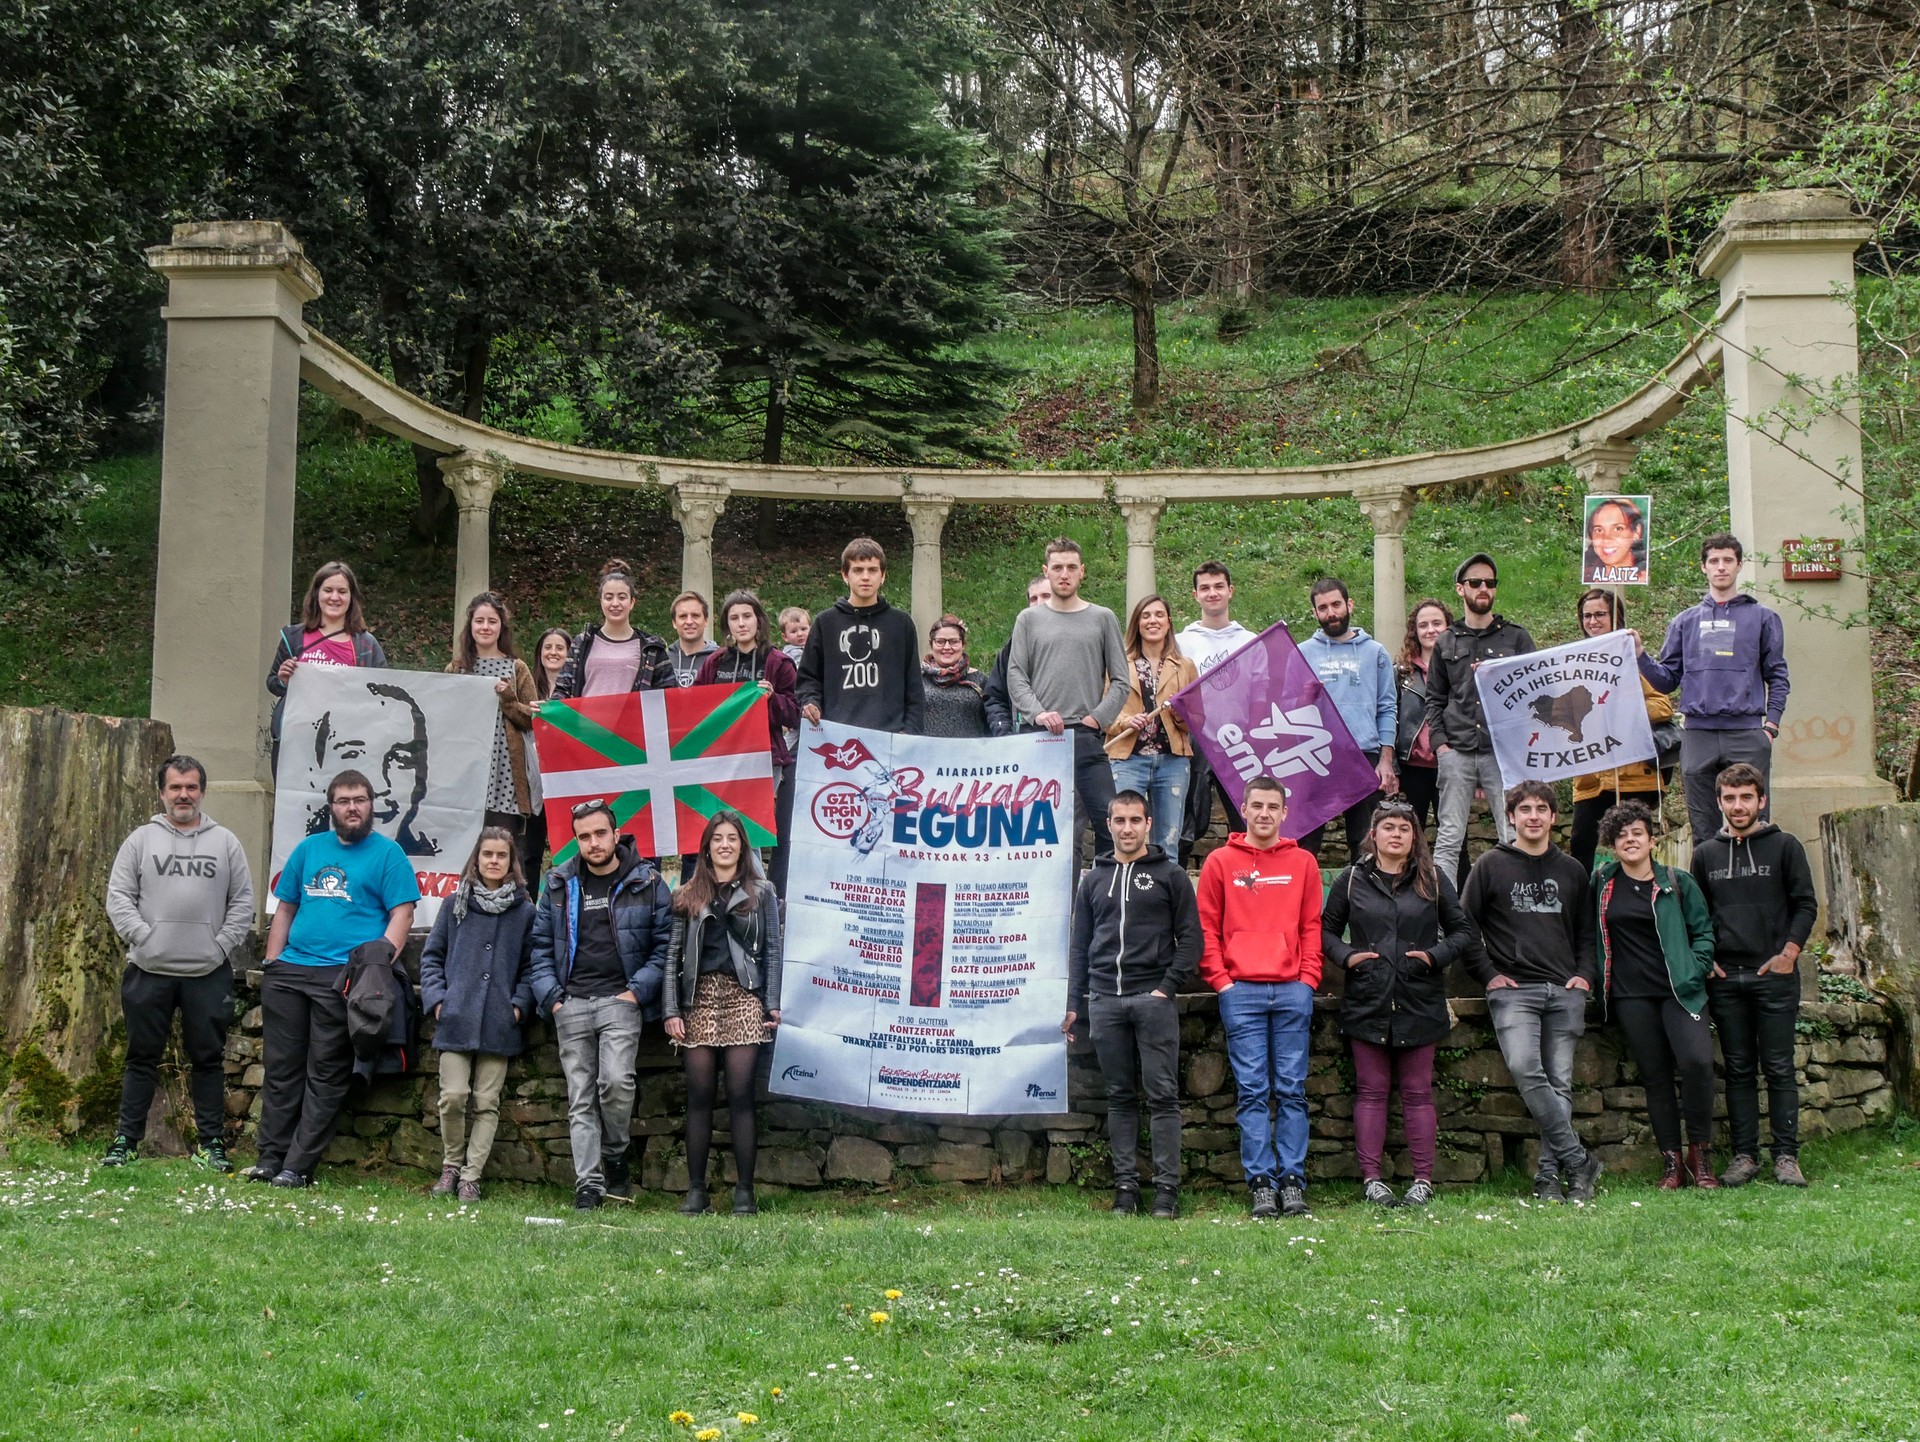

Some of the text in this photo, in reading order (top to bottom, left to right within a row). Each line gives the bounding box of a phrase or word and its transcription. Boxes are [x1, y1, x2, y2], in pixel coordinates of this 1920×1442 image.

[1592, 566, 1639, 582] ALAITZ
[302, 649, 327, 659] mihi
[842, 662, 879, 690] ZOO
[1493, 652, 1623, 696] EUSKAL PRESO
[1503, 669, 1621, 711] ETA IHESLARIAK
[1526, 735, 1623, 768] ETXERA
[937, 764, 1020, 777] AIARALDEKO
[826, 793, 856, 805] GZT
[821, 806, 862, 818] TPGN
[836, 818, 855, 831] 19
[892, 798, 1060, 849] EGUNA
[899, 849, 967, 862] MARTXOAK
[974, 853, 989, 862] 23
[1008, 850, 1053, 861] LAUDIO
[152, 854, 217, 879] VANS
[846, 874, 907, 888] 12:00 HERRIKO PLAZA
[975, 883, 997, 892] ELIZAKO
[997, 882, 1028, 890] ARKUPETAN
[830, 882, 906, 898] TXUPINAZOA ETA
[954, 891, 1030, 902] HERRI BAZKARIA
[844, 893, 905, 907] HERRI AZOKA
[844, 923, 904, 938] 12:30 HERRIKO PLAZA
[952, 933, 1028, 944] AÑUBEKO TROBA
[849, 939, 903, 955] ALTSASU ETA
[859, 950, 902, 963] AMURRIO
[951, 955, 967, 963] 18:00
[1007, 953, 1027, 961] KALEAN
[951, 962, 1036, 974] GAZTE OLINPIADAK
[853, 970, 875, 980] HERRIKO
[812, 976, 900, 999] BUILAKA BATUKADA
[949, 987, 1020, 999] MANIFESTAZIOA
[898, 1015, 948, 1026] 21:00 GAZTETXEA
[889, 1024, 955, 1037] KONTZERTUAK
[842, 1035, 888, 1049] OHARKABE
[896, 1043, 906, 1051] DJ
[909, 1045, 947, 1054] POTTORS
[950, 1046, 1002, 1056] DESTROYERS
[869, 1033, 927, 1046] IZATEFALTSUA
[935, 1039, 974, 1047] EZTANDA
[879, 1074, 961, 1089] INDEPENDENTZIARA!
